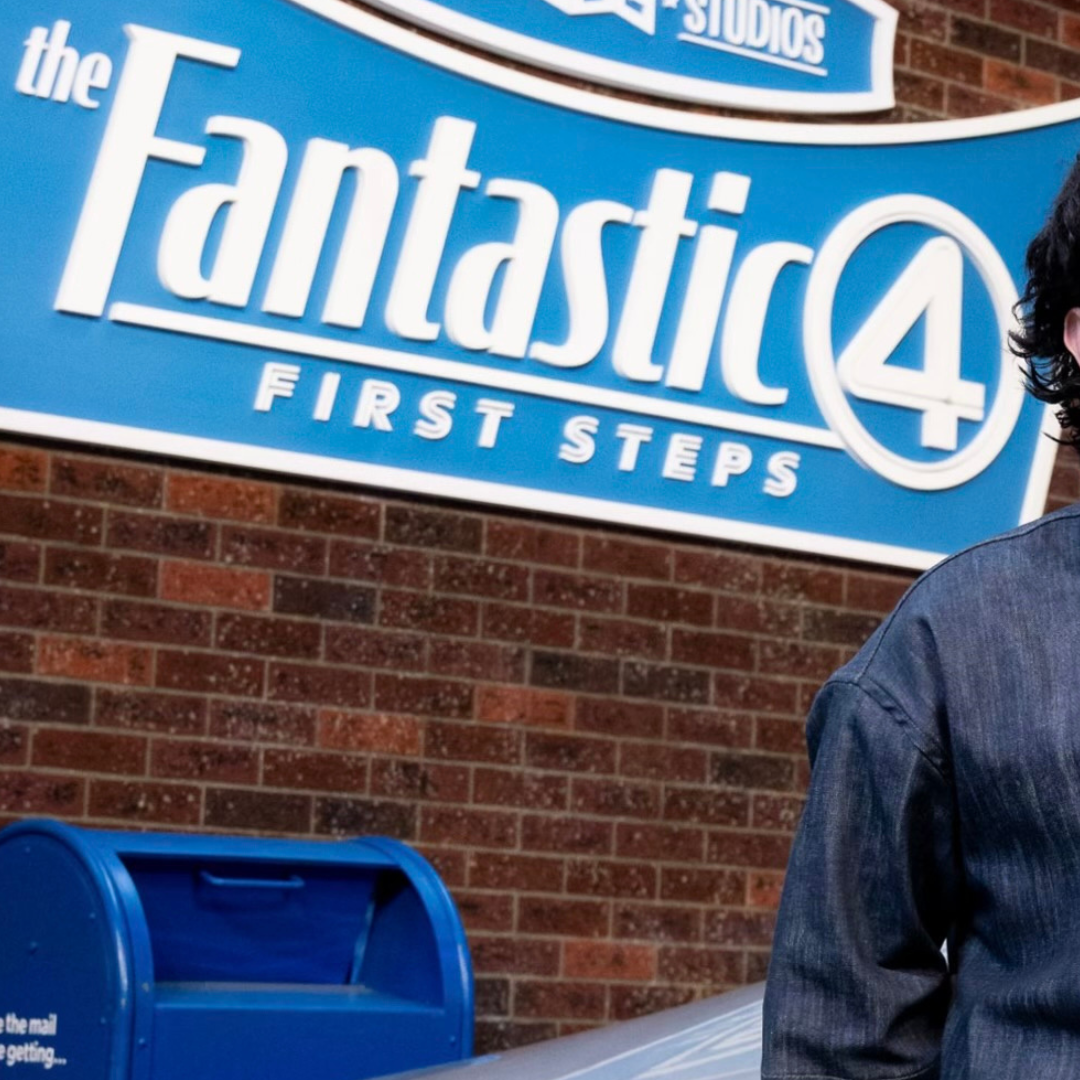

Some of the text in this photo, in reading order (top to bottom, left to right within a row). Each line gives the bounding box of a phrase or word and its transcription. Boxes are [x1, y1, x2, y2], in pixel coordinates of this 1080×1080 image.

[14, 19, 113, 109] the
[683, 0, 826, 65] STUDIOS
[53, 22, 814, 406] Fantastic
[253, 361, 800, 498] FIRST STEPS
[6, 1012, 27, 1035] the
[28, 1012, 57, 1035] mail
